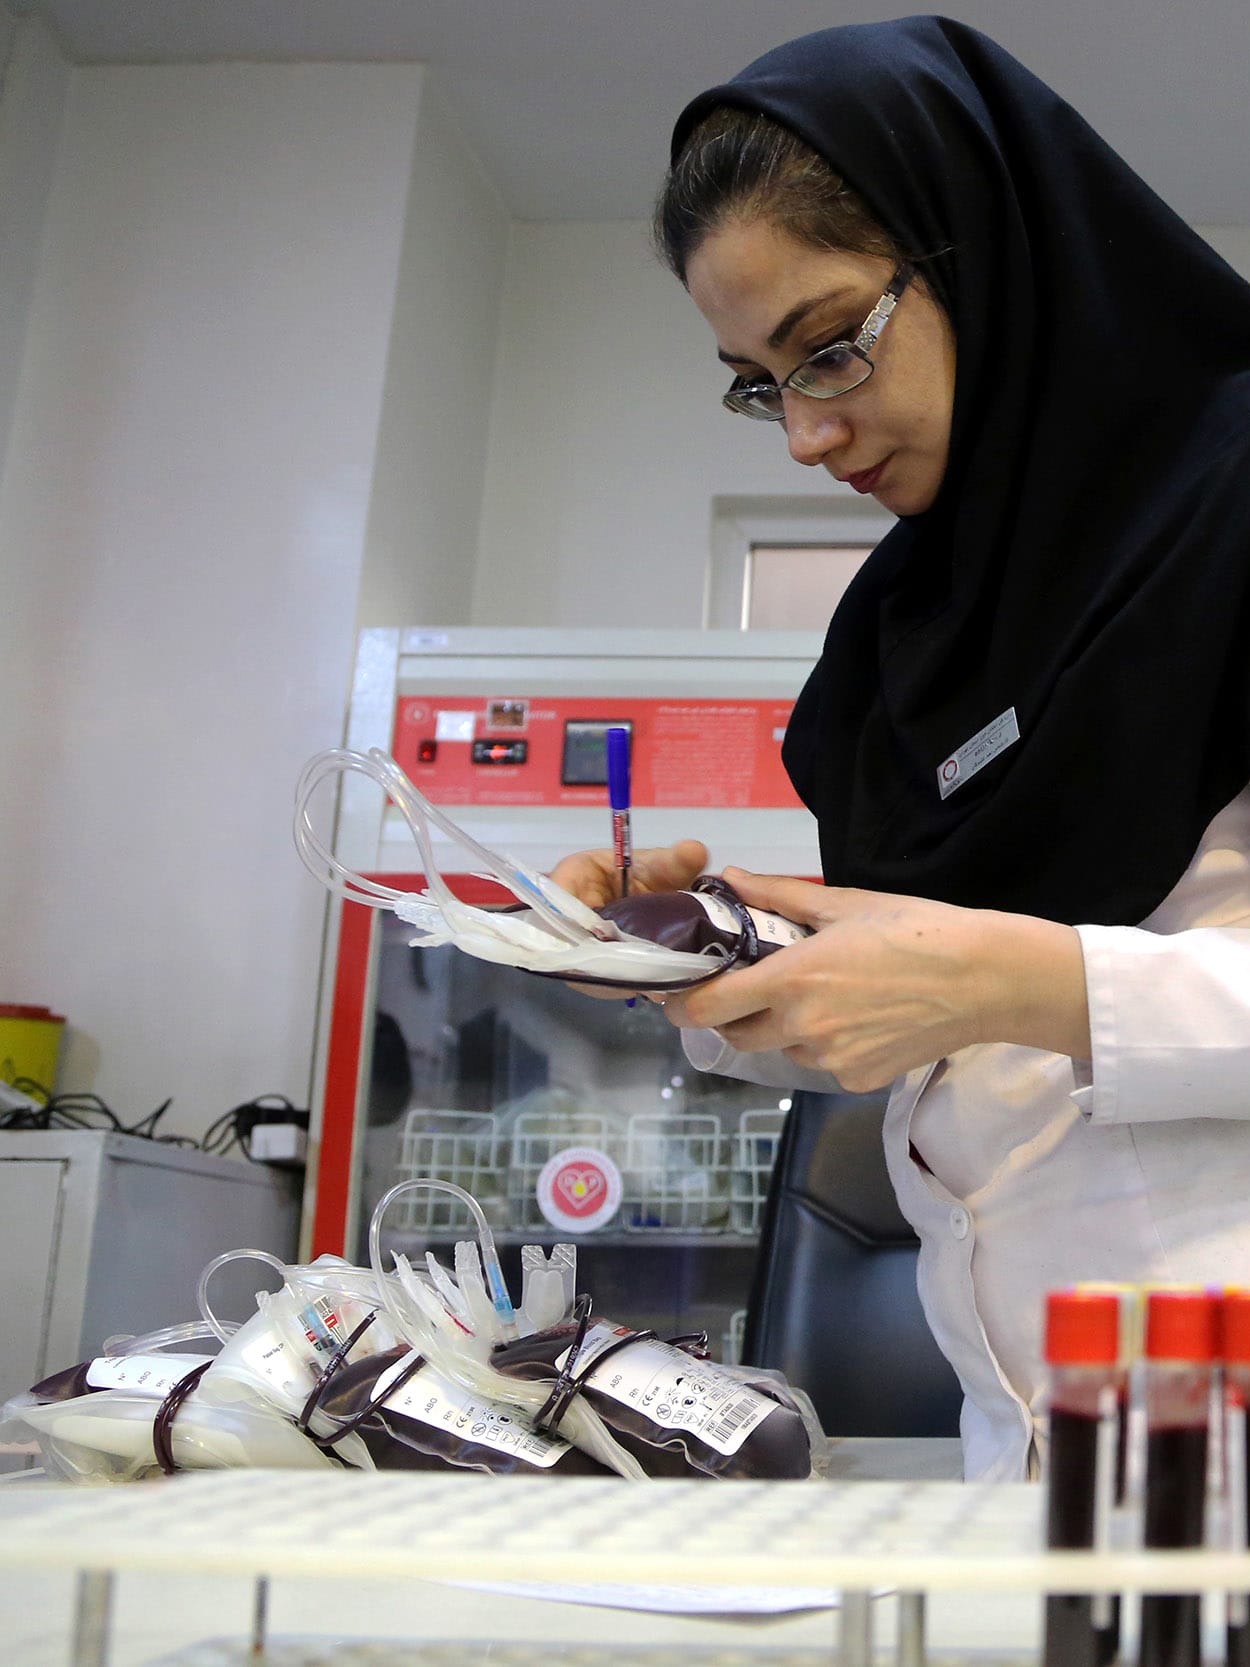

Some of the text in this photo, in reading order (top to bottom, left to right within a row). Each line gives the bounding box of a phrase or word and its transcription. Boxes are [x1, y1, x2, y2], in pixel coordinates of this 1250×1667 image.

[137, 1371, 151, 1384] ABO
[610, 1374, 623, 1389] ABO
[628, 1387, 640, 1398] Rh
[424, 1397, 438, 1414] ABO
[642, 1394, 654, 1407] CE
[443, 1410, 454, 1421] Rh
[456, 1415, 468, 1429] CE
